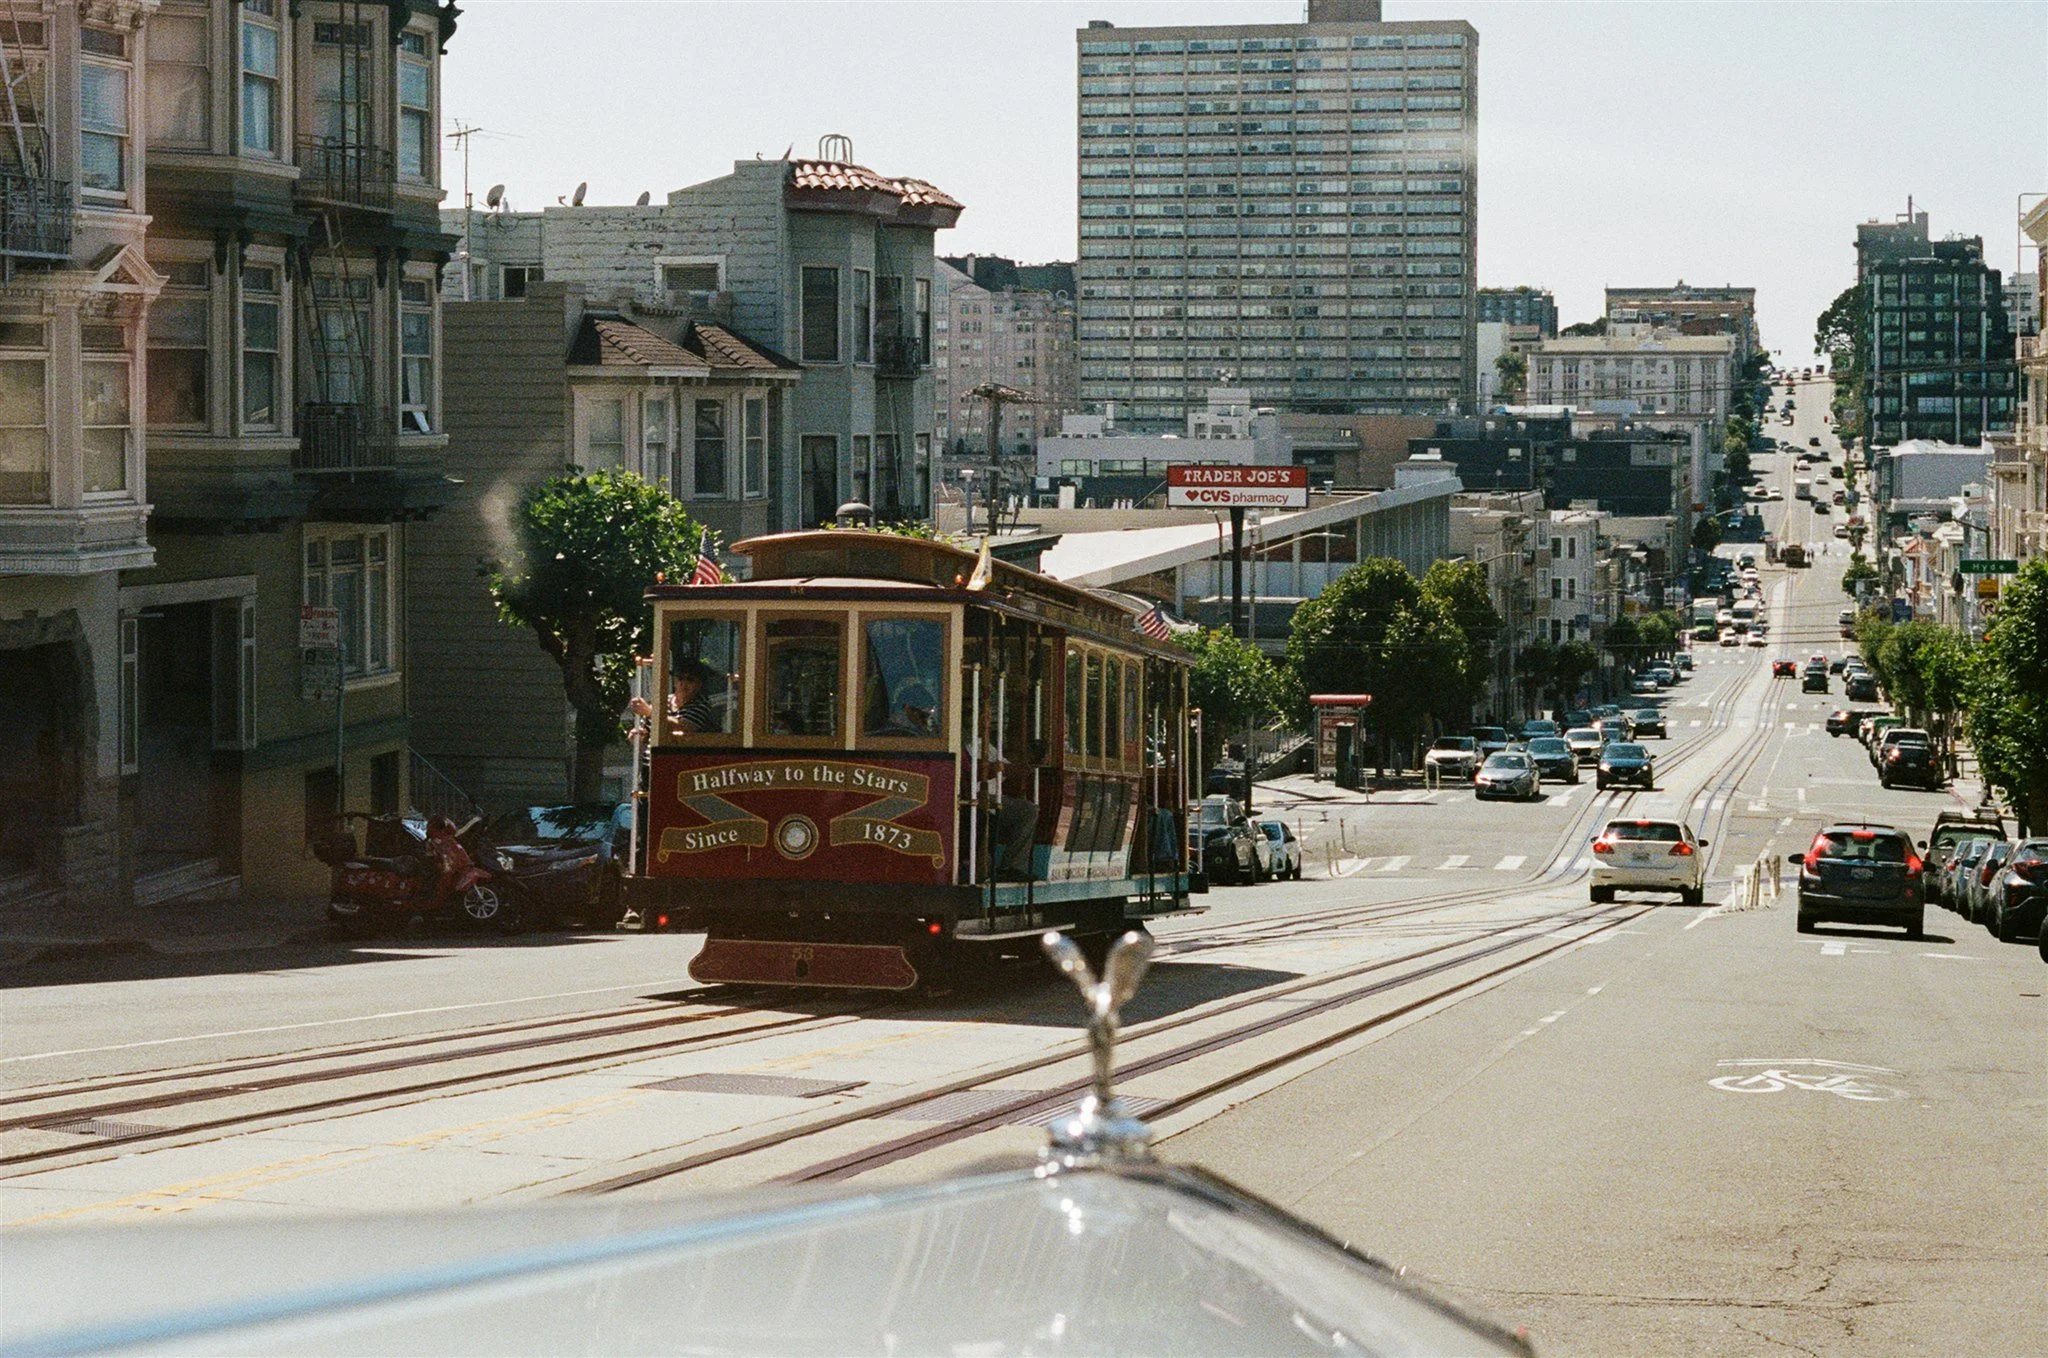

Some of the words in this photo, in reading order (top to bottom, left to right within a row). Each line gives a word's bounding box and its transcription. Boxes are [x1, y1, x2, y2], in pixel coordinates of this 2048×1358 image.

[1183, 470, 1243, 483] TRADER
[1246, 469, 1291, 483] JOE'S
[1200, 490, 1231, 503] CVS
[1232, 492, 1289, 505] pharmacy
[1973, 563, 2005, 571] Hyde
[693, 767, 776, 791] Halfway
[785, 768, 804, 781] to
[813, 765, 845, 783] the
[852, 767, 909, 794] Stars
[685, 827, 738, 849] Since
[863, 822, 912, 849] 1873
